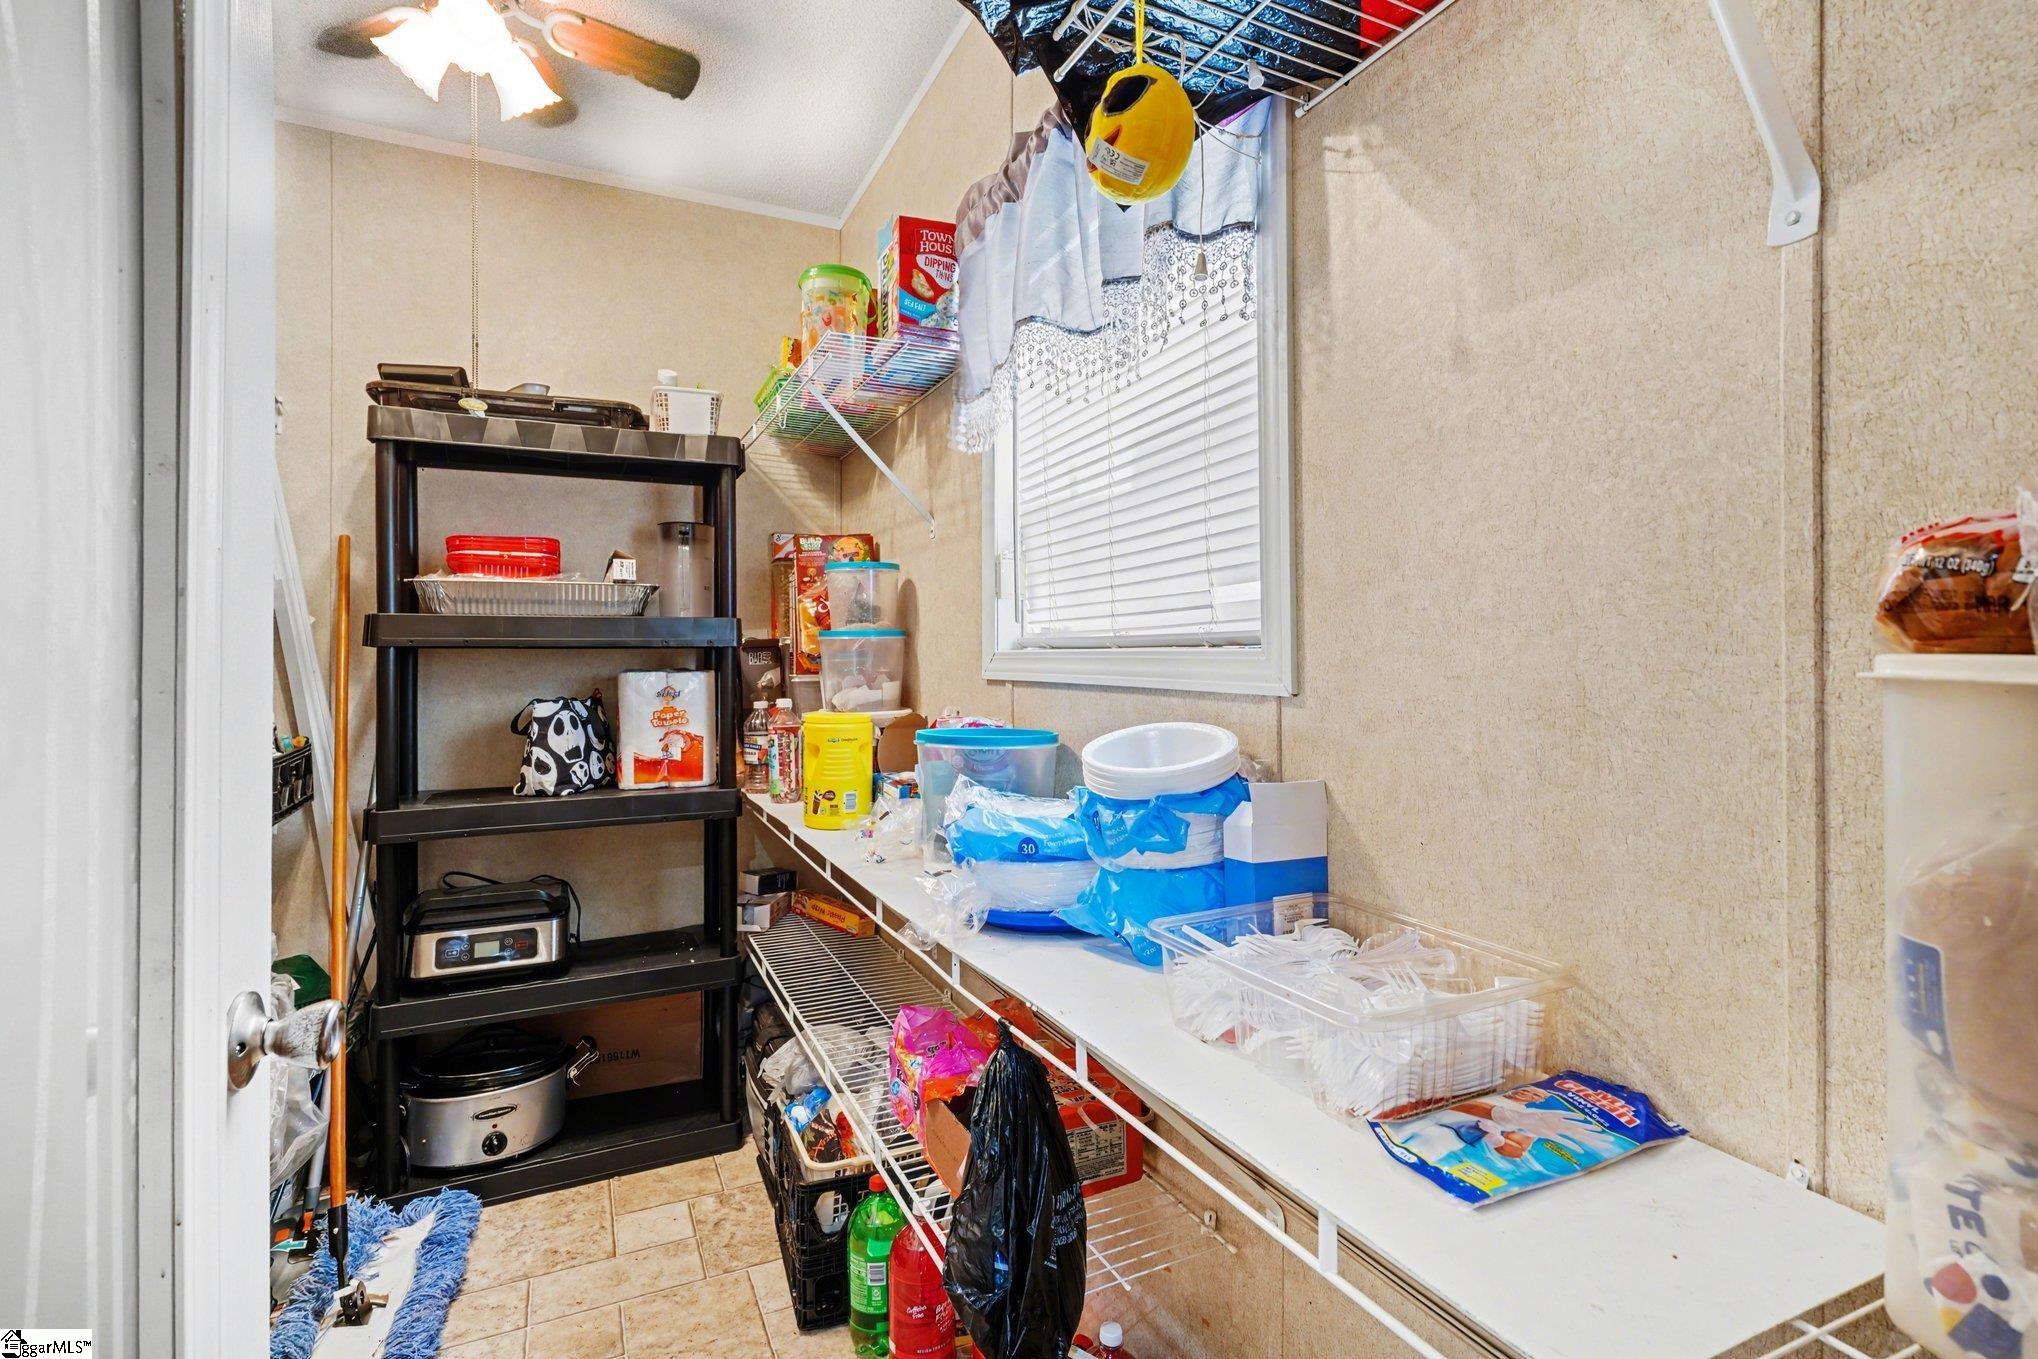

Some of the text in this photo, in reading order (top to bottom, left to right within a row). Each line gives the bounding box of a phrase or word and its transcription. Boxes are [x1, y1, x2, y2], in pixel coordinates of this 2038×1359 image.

[920, 229, 955, 244] TOWN
[920, 241, 957, 255] HOUS
[924, 256, 956, 273] DIPPING
[935, 269, 954, 283] THINS
[1946, 557, 1960, 570] OZ
[1961, 558, 1995, 577] (340g)
[653, 710, 687, 720] Paper
[651, 718, 688, 727] Towels
[1021, 843, 1036, 855] 30
[1554, 1080, 1641, 1128] Clean
[912, 1312, 924, 1320] Free
